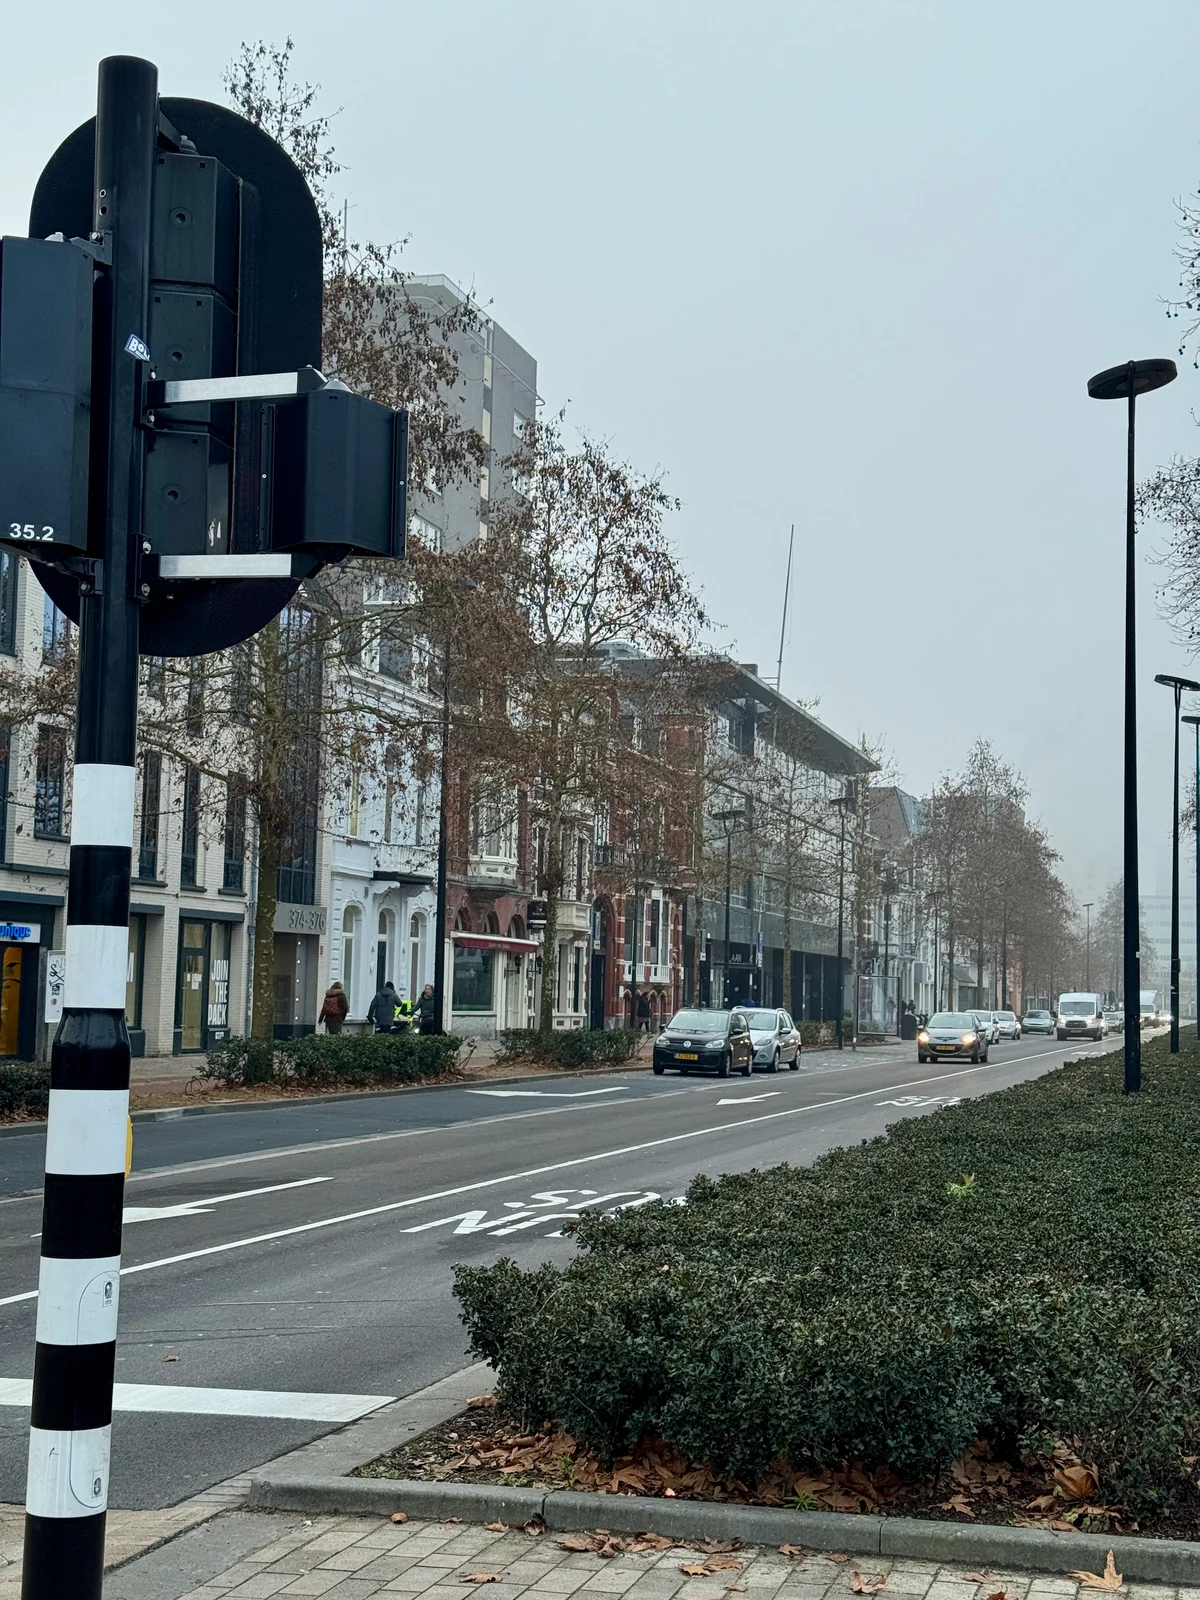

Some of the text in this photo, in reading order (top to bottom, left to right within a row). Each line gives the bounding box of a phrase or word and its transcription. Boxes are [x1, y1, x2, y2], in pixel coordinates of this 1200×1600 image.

[9, 522, 54, 542] 35.2
[288, 909, 325, 931] 374-376
[211, 959, 229, 981] JOIN
[214, 981, 229, 1003] THE
[207, 1003, 228, 1026] PACK
[503, 1189, 688, 1211] US
